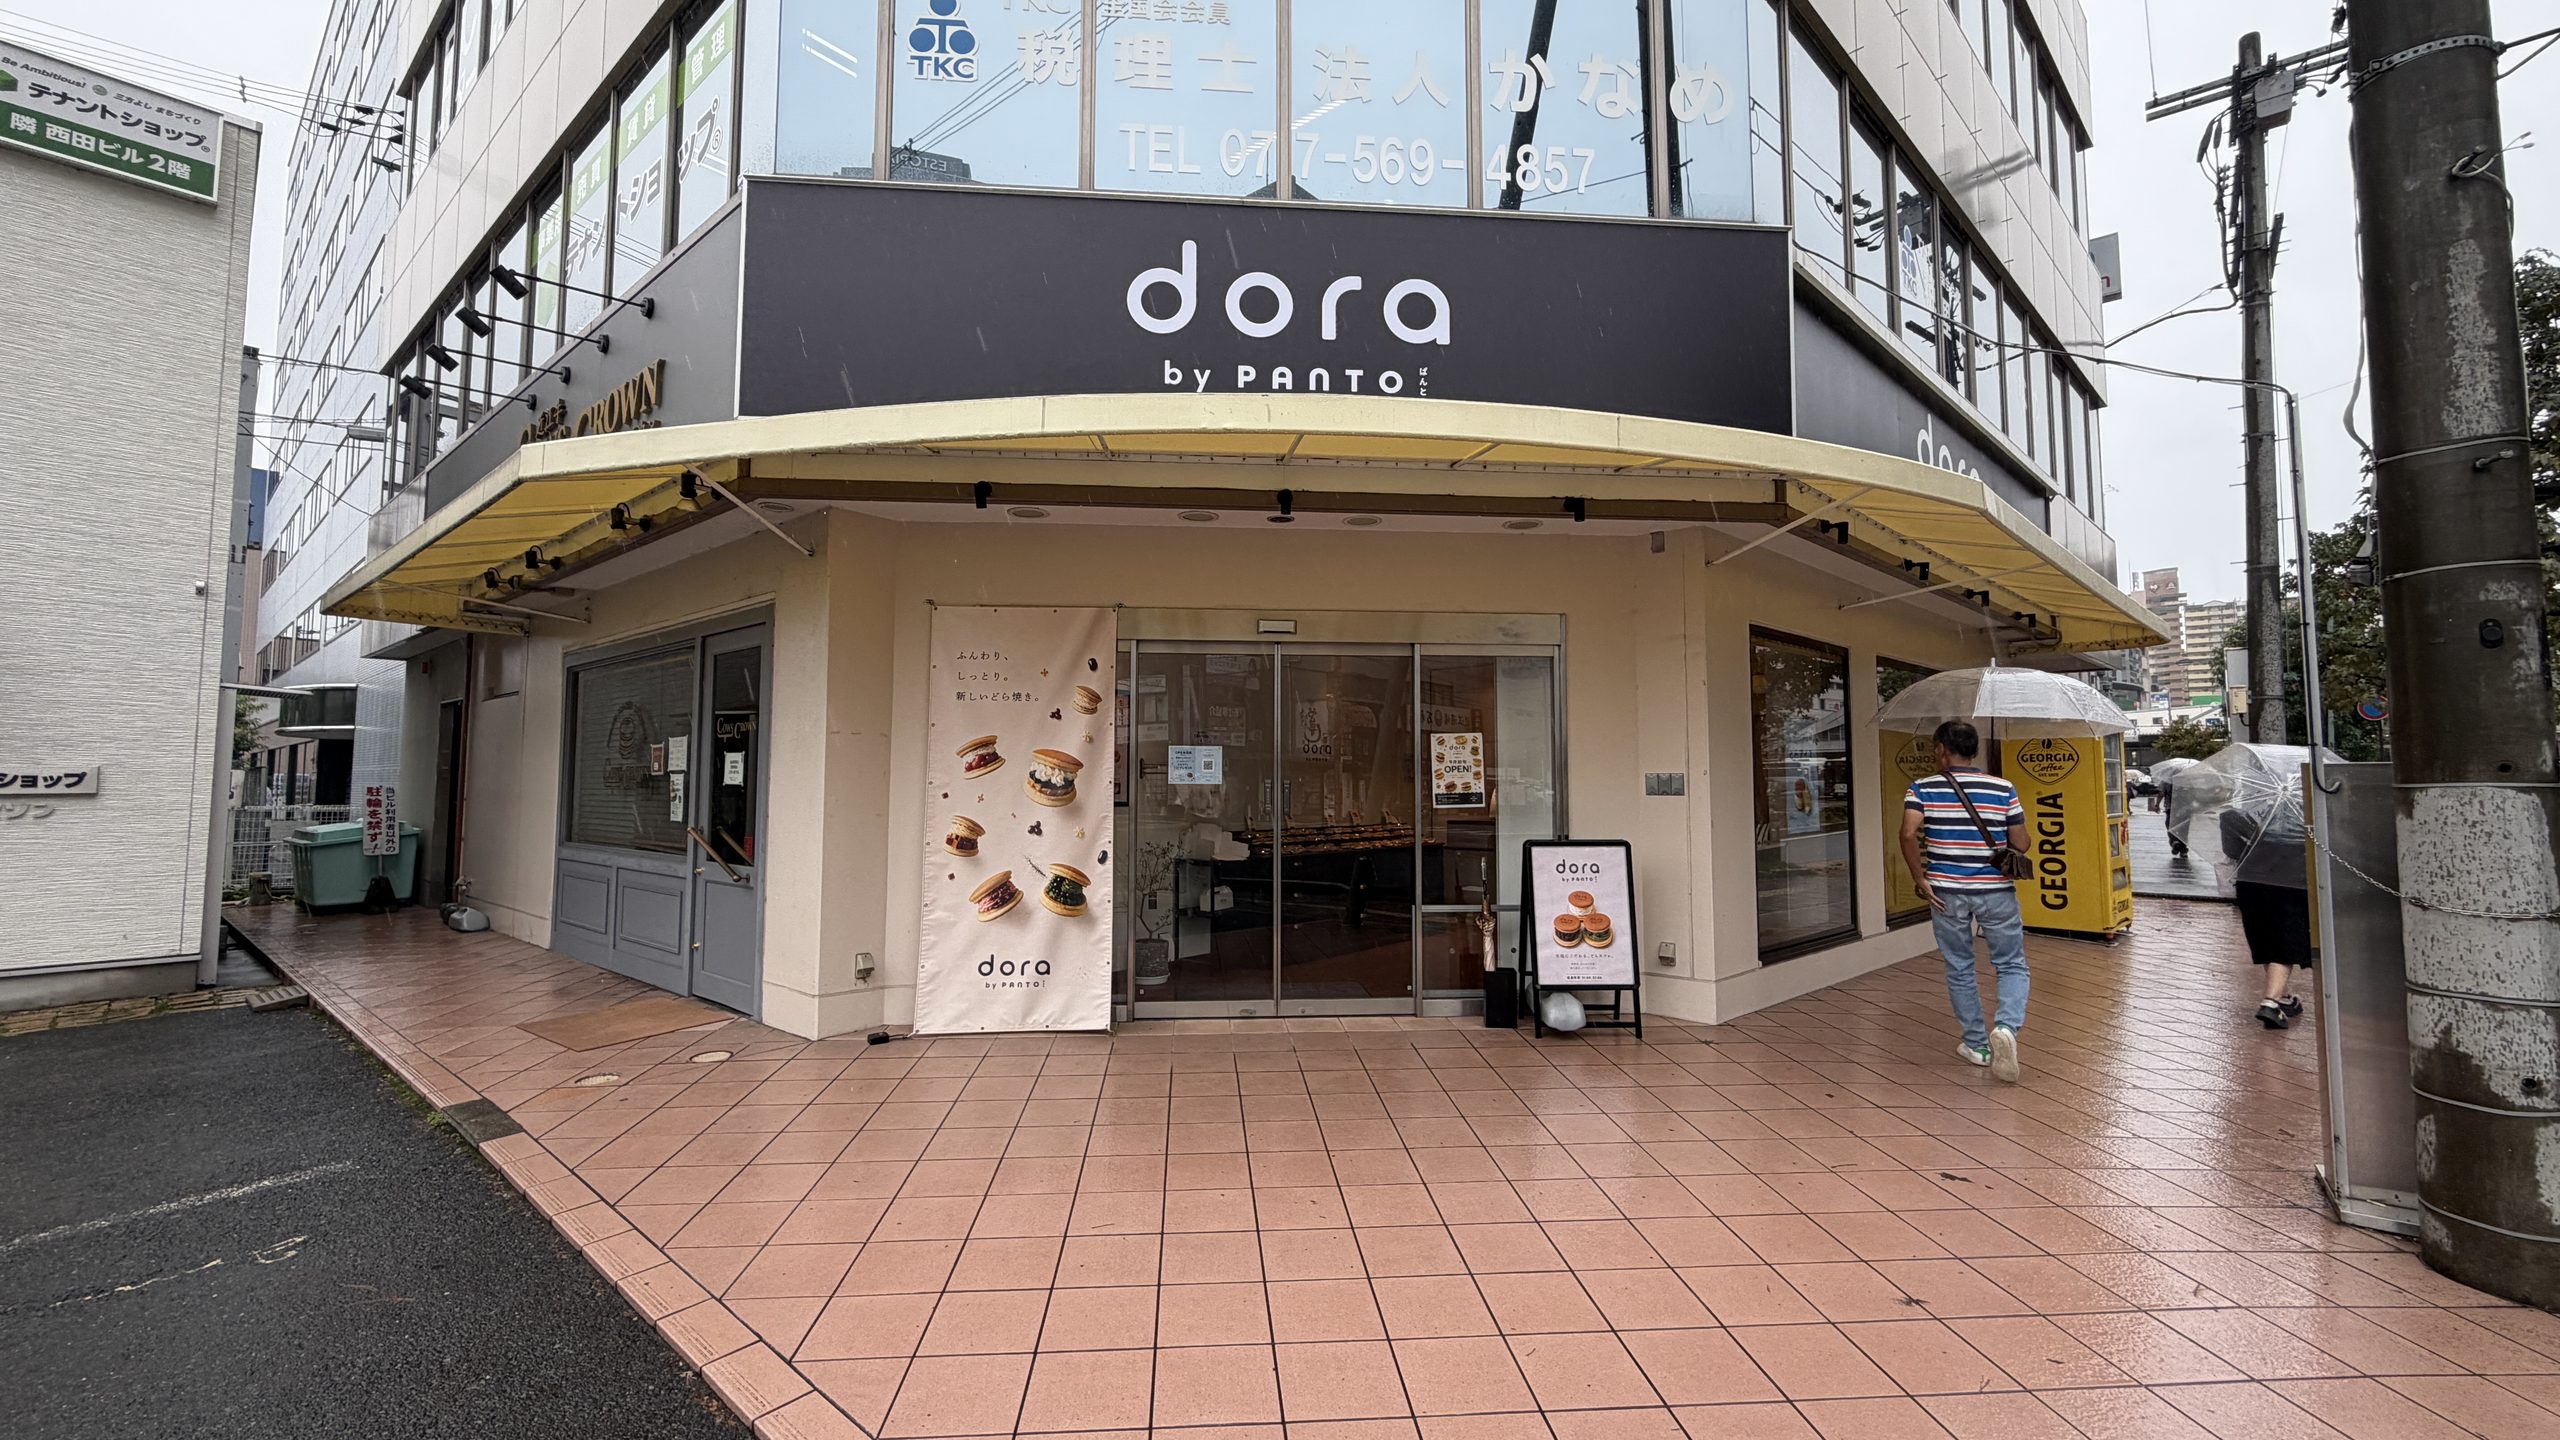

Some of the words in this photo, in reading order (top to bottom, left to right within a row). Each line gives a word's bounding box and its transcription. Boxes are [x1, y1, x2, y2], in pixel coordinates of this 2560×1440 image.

[1, 56, 18, 67] Be
[20, 63, 87, 89] Ambitious!
[910, 54, 975, 79] TKC
[1015, 27, 1734, 126] 税理士法人かなめ
[113, 92, 153, 110] 三方よし
[155, 106, 201, 125] まちづくり
[576, 155, 601, 204] 売買
[626, 93, 656, 148] 賃貸
[691, 22, 725, 85] 管理
[10, 112, 38, 135] 隣
[45, 122, 192, 180] 西田ビル2階
[1119, 123, 1201, 174] TEL
[1218, 127, 1596, 195] 077-569-4857
[1126, 239, 1451, 345] dora
[1164, 359, 1211, 393] by
[1237, 364, 1404, 394] PANTO
[957, 651, 1008, 661] ふんわり、
[958, 671, 1009, 682] しっとり。
[956, 691, 1039, 702] 新しいどら焼き。
[1444, 765, 1472, 773] OPEN!
[2020, 753, 2075, 763] GEORGIA
[2032, 764, 2065, 773] Coffee
[385, 786, 396, 853] 当ビル利用者以外の
[2037, 791, 2068, 911] GEORGIA
[1555, 858, 1600, 874] dora
[978, 953, 1051, 976] dora
[985, 981, 997, 990] by
[1001, 980, 1040, 988] PANTO
